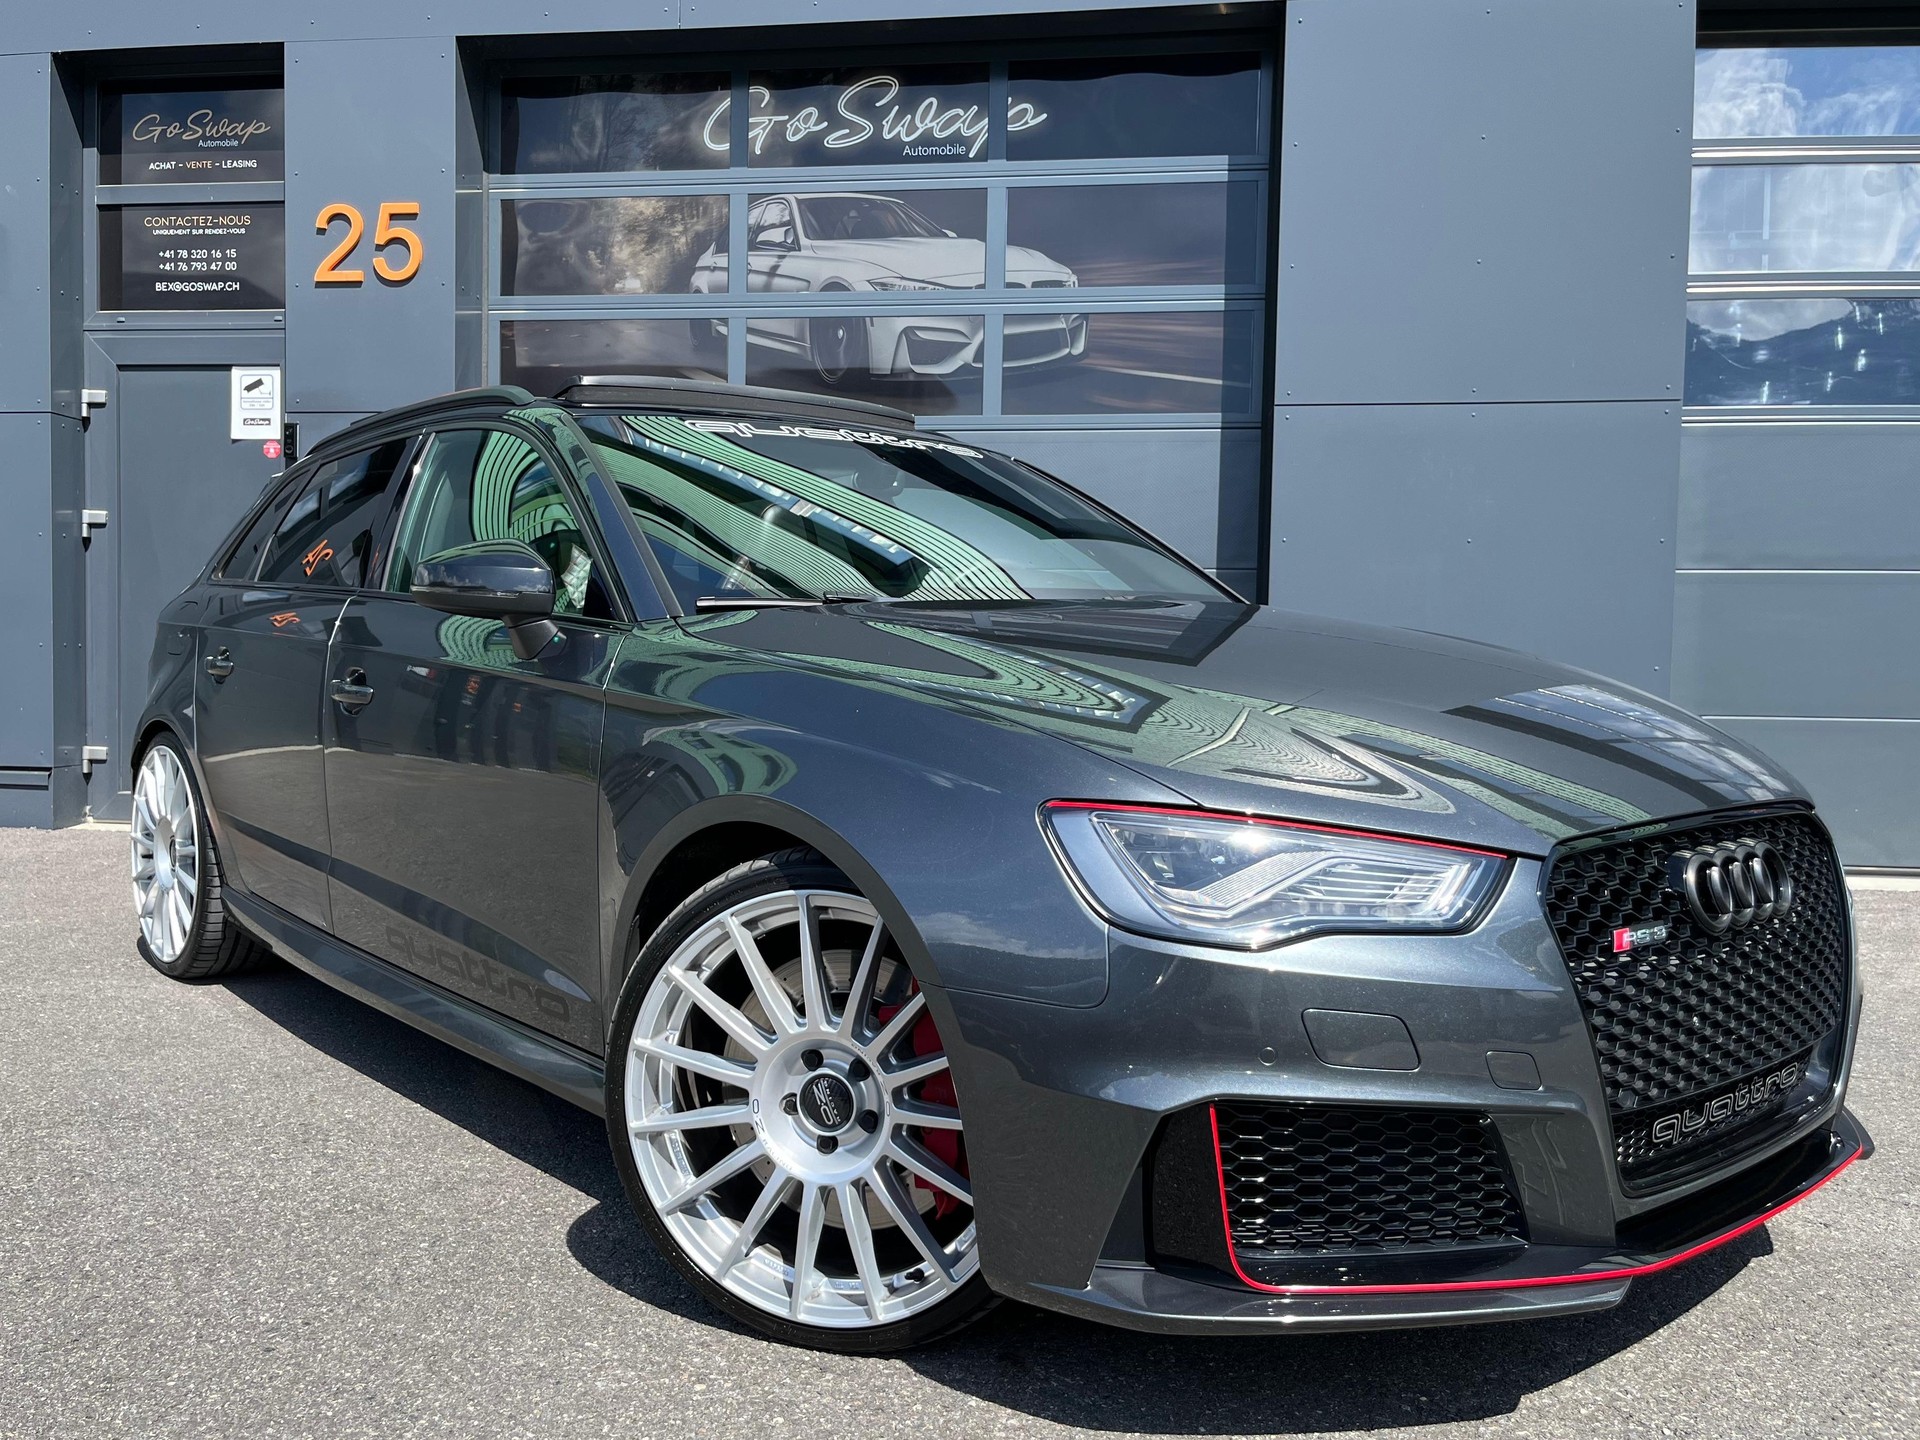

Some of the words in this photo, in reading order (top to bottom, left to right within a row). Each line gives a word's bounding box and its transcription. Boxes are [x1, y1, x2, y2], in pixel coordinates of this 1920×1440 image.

[198, 139, 239, 148] Automobile
[902, 143, 967, 157] Automobile
[149, 161, 176, 170] ACHAT
[185, 160, 213, 169] VENTE
[222, 159, 258, 169] LEASING
[144, 215, 251, 227] CONTACTEZ-NOUS
[152, 228, 190, 236] UNIQUEMENT
[204, 227, 246, 235] RENDEZ-VOUS
[314, 202, 424, 284] 25
[158, 249, 175, 259] +41
[177, 249, 189, 259] 78
[190, 249, 208, 259] 320
[211, 249, 222, 259] 16
[225, 248, 237, 258] 15
[158, 262, 175, 271] +41
[177, 262, 188, 271] 76
[190, 262, 208, 271] 793
[210, 262, 222, 271] 47
[225, 261, 237, 271] 00
[155, 281, 240, 292] BEX@GOSWAP.CH
[684, 419, 984, 459] quattro
[386, 925, 570, 1022] quattro
[1652, 1061, 1799, 1144] quattro
